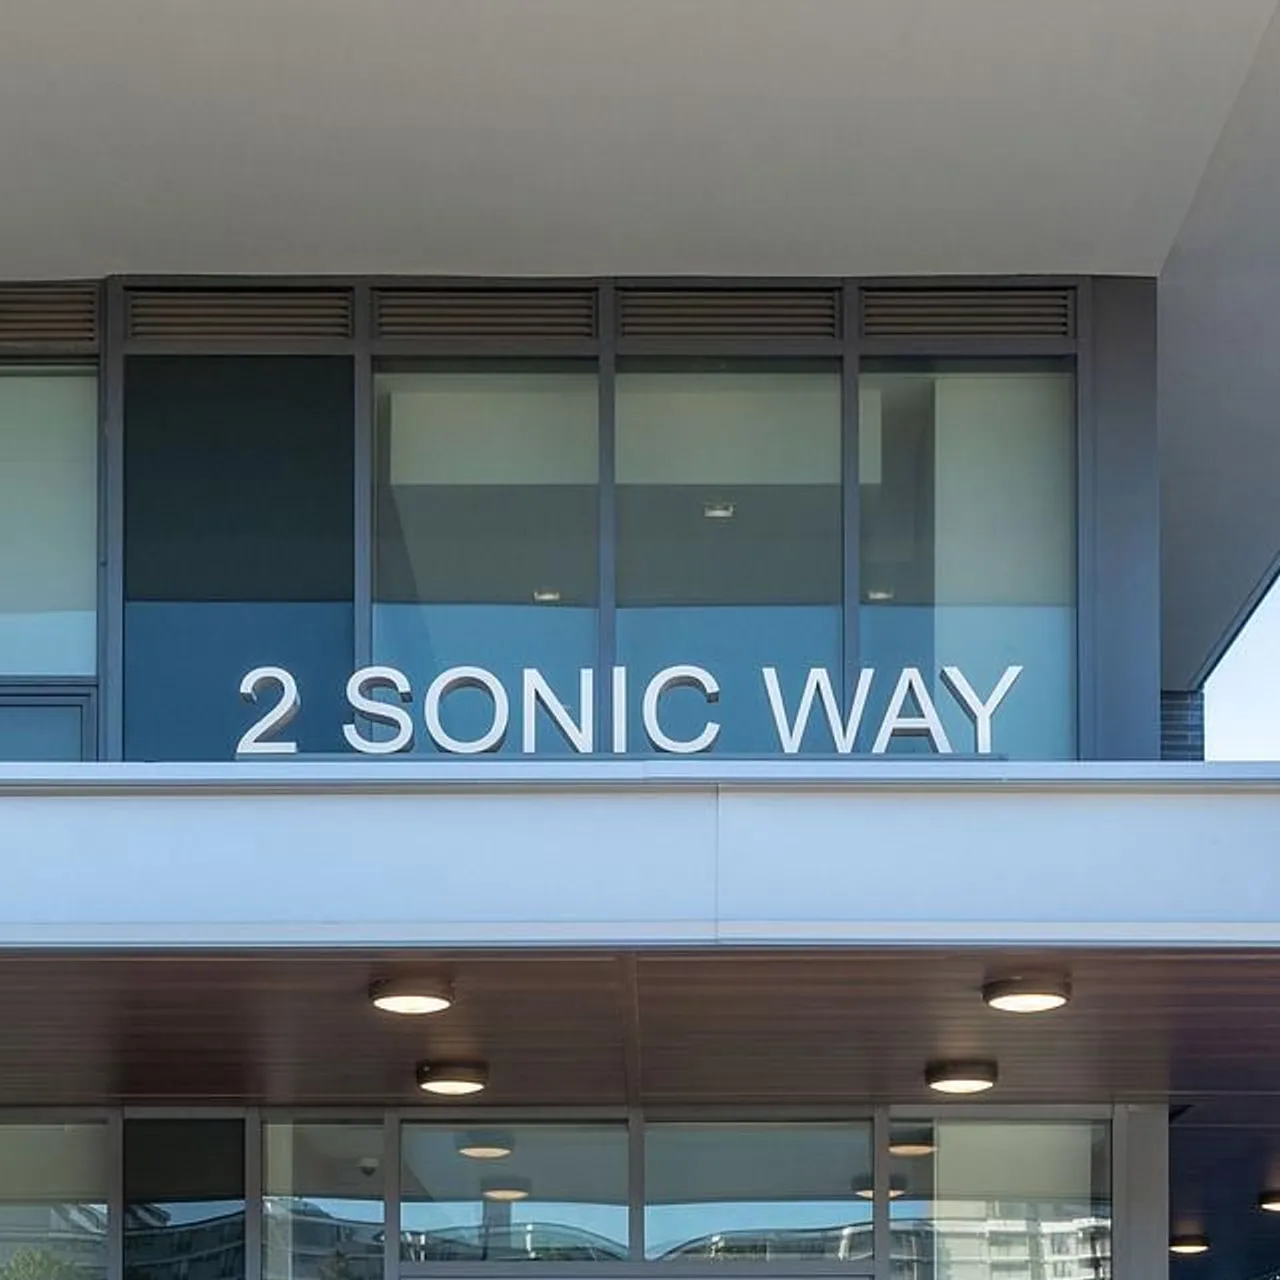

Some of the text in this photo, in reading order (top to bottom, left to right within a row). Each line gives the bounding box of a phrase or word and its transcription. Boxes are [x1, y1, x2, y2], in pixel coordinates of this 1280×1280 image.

[235, 665, 1024, 754] 2 SONIC WAY
